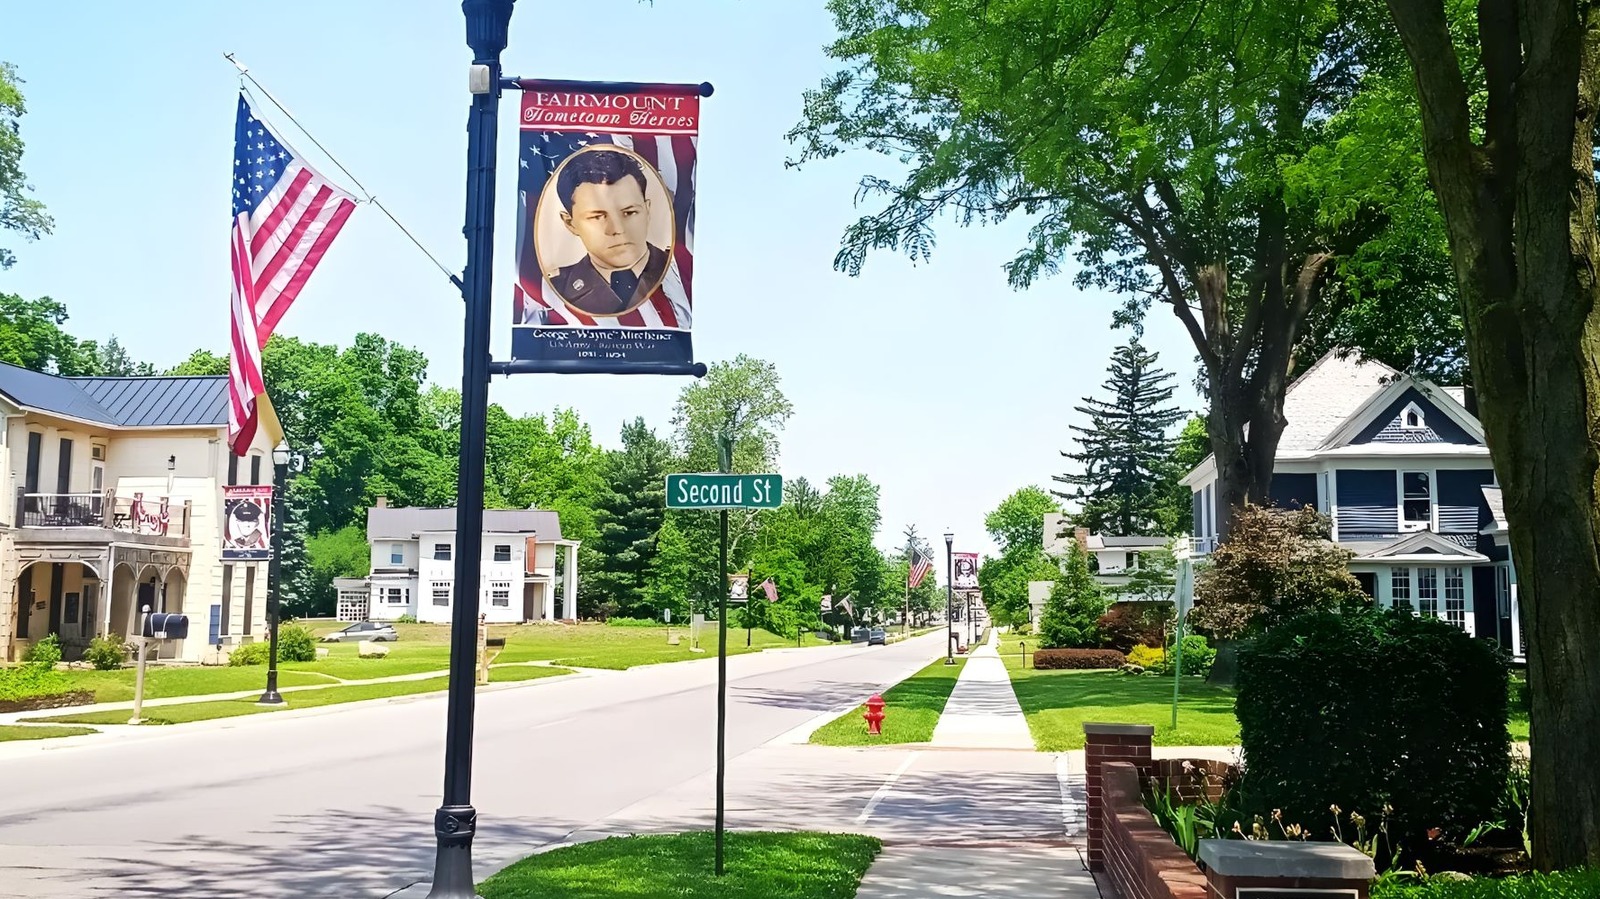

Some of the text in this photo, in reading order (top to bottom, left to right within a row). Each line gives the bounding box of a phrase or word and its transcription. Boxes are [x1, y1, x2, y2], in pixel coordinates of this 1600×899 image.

[537, 93, 684, 110] FAIRMOUNT
[524, 108, 694, 127] Hometown Heroes
[678, 479, 771, 504] Second St
